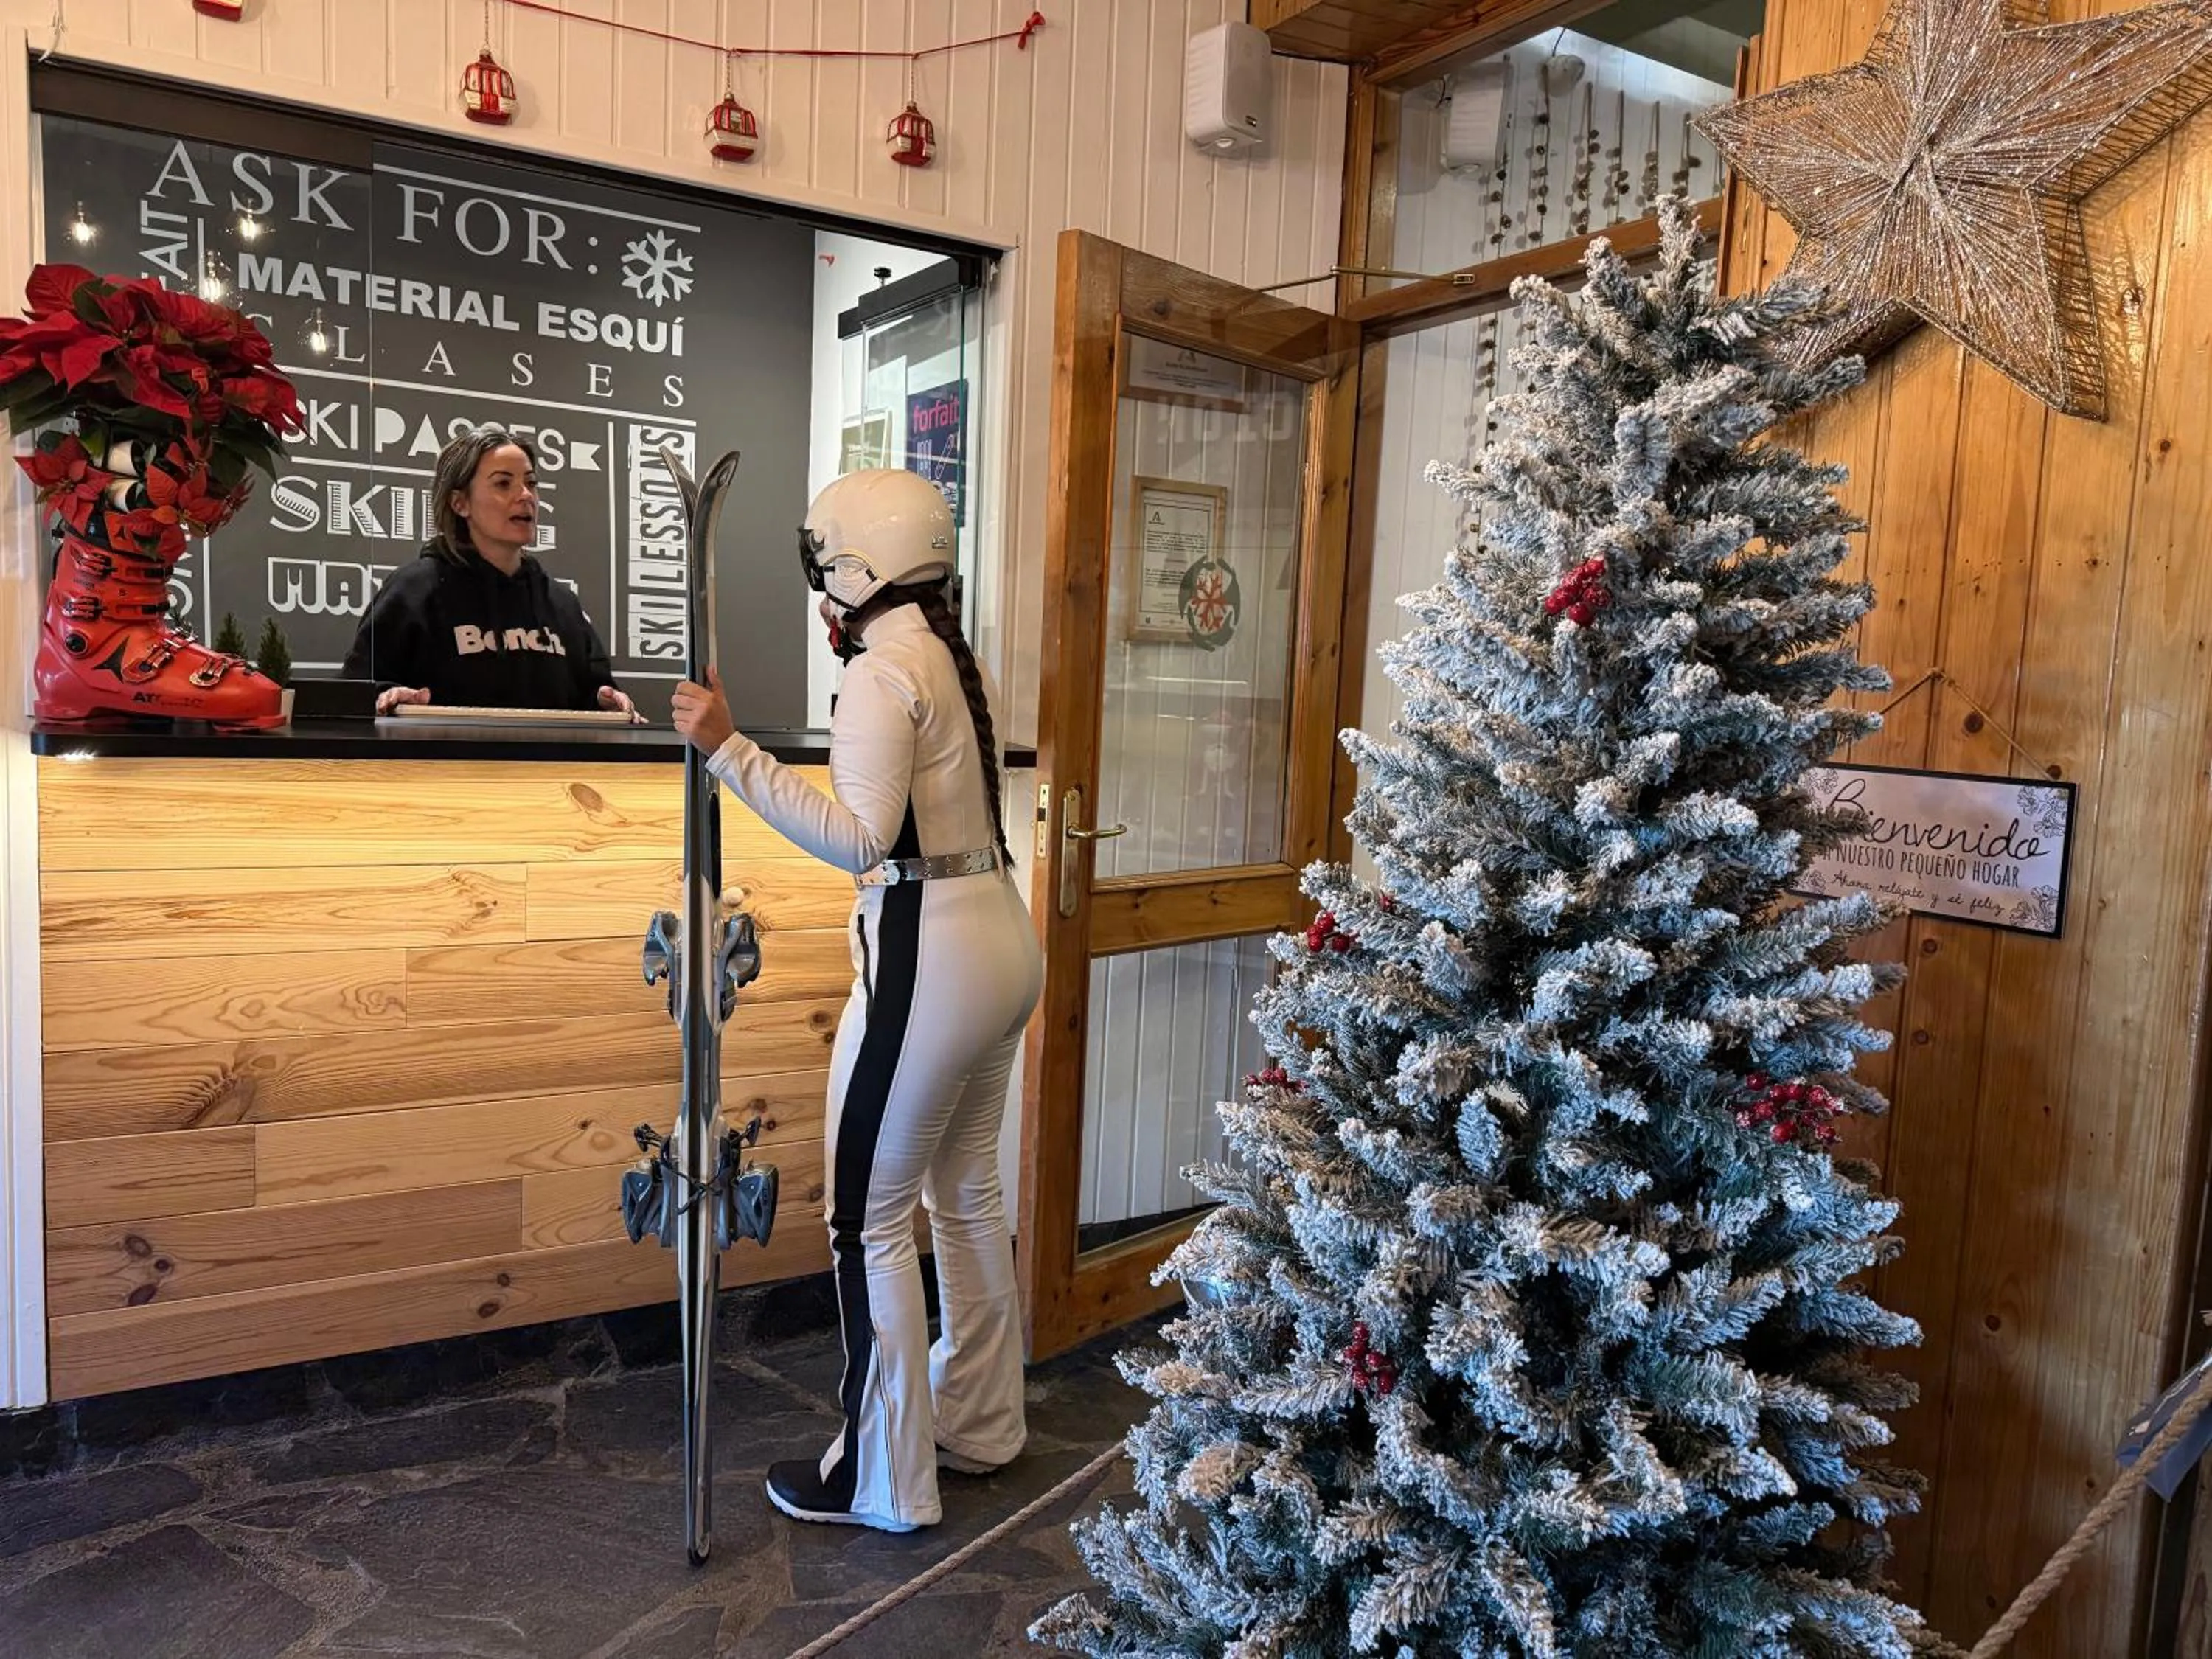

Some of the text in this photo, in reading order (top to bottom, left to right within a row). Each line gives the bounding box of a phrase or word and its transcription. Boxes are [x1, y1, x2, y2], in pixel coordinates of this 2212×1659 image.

[138, 199, 188, 295] AIT
[145, 140, 599, 274] ASK FOR:
[238, 253, 685, 357] MATERIAL ESQUÍ
[914, 392, 960, 434] forfait
[639, 428, 685, 657] SKI LESSONS
[1837, 844, 1894, 870] NUESTRO
[1899, 851, 1966, 880] PEQUEÑO
[1972, 860, 2020, 888] HOGAR
